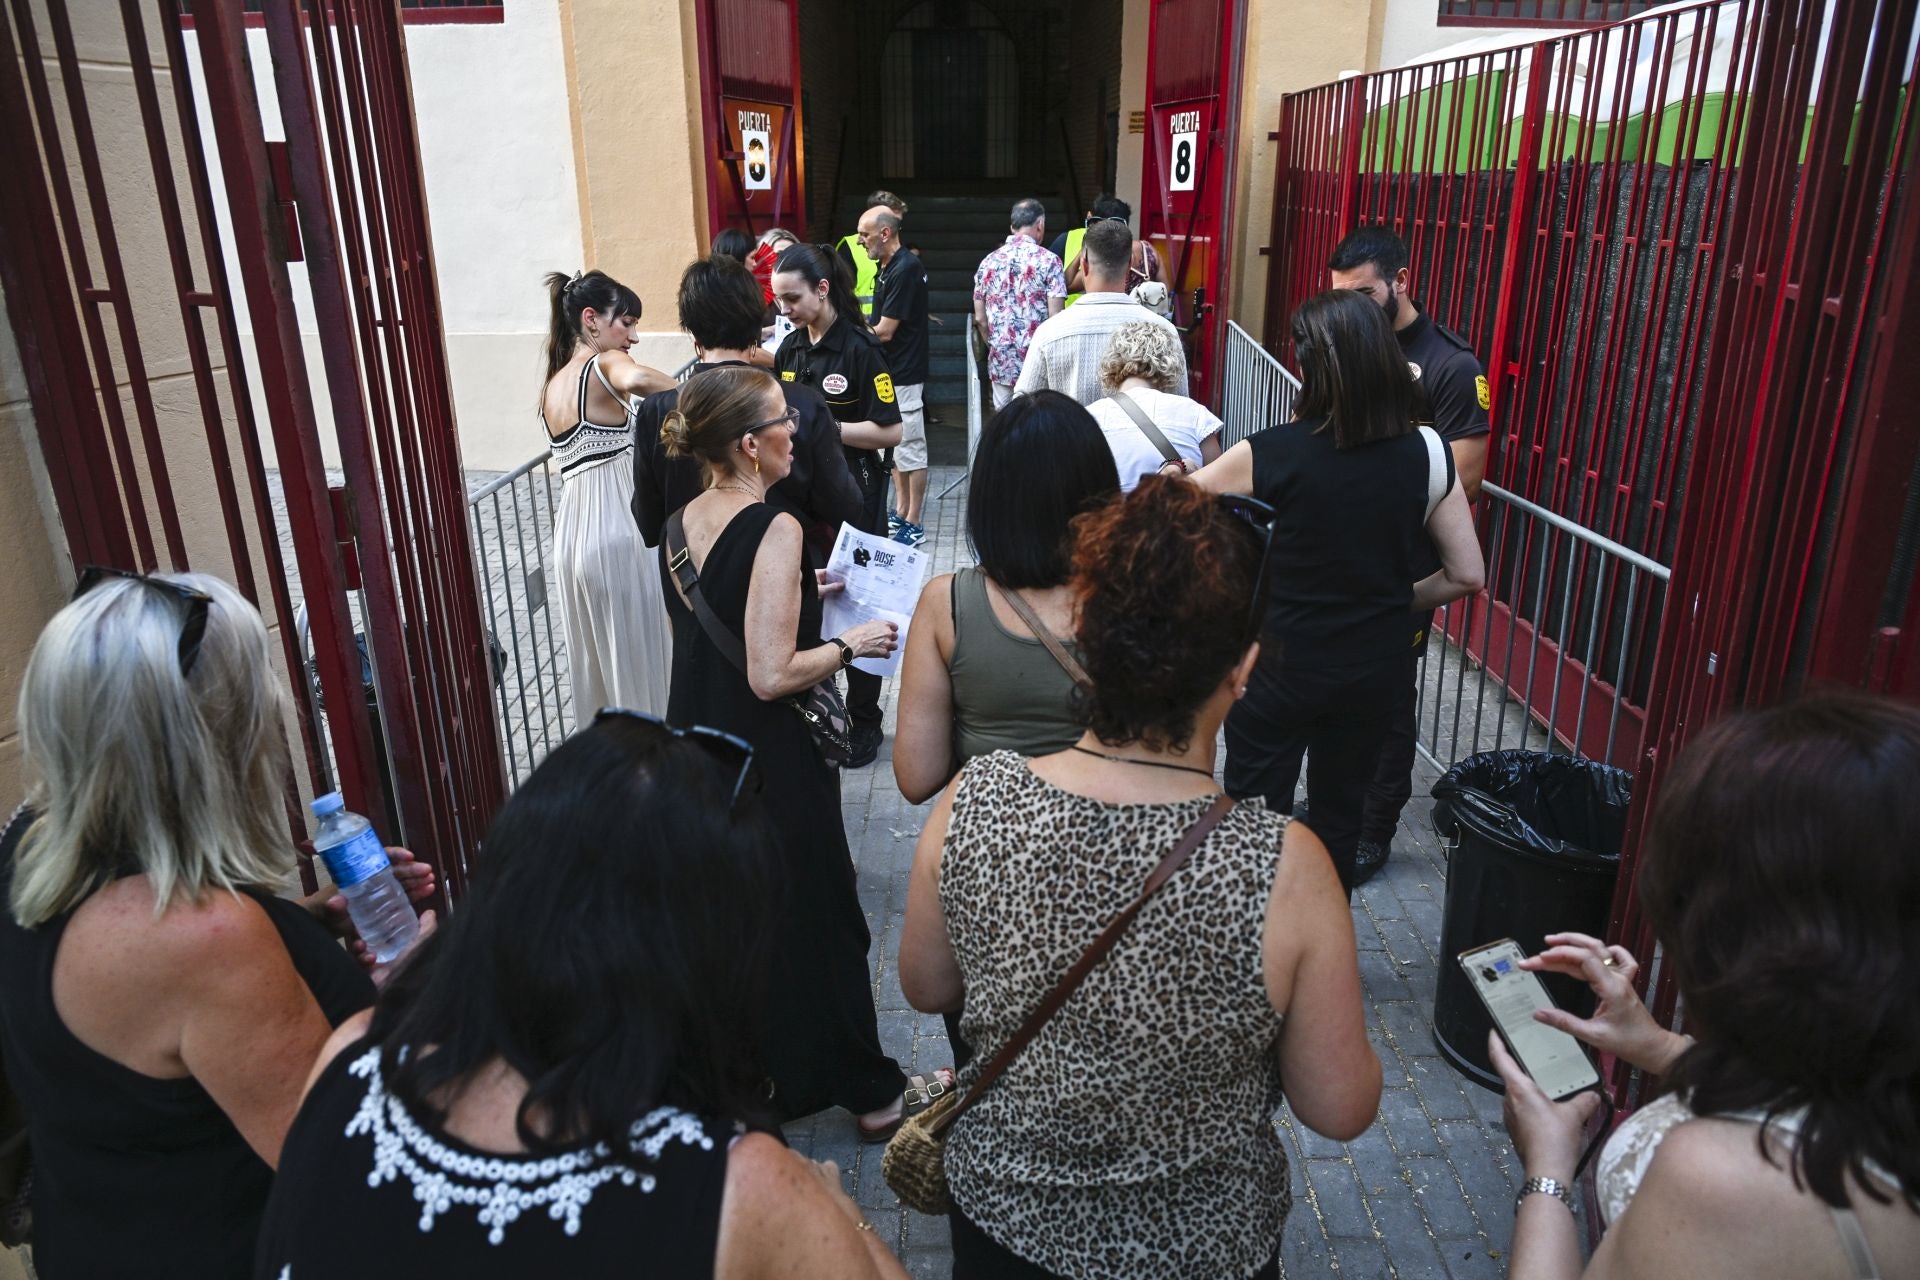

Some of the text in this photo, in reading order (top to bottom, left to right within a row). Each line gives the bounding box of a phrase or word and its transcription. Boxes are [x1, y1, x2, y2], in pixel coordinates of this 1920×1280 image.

[738, 110, 772, 133] PUERTA
[1170, 110, 1200, 134] PUERTA
[1175, 140, 1191, 183] 8
